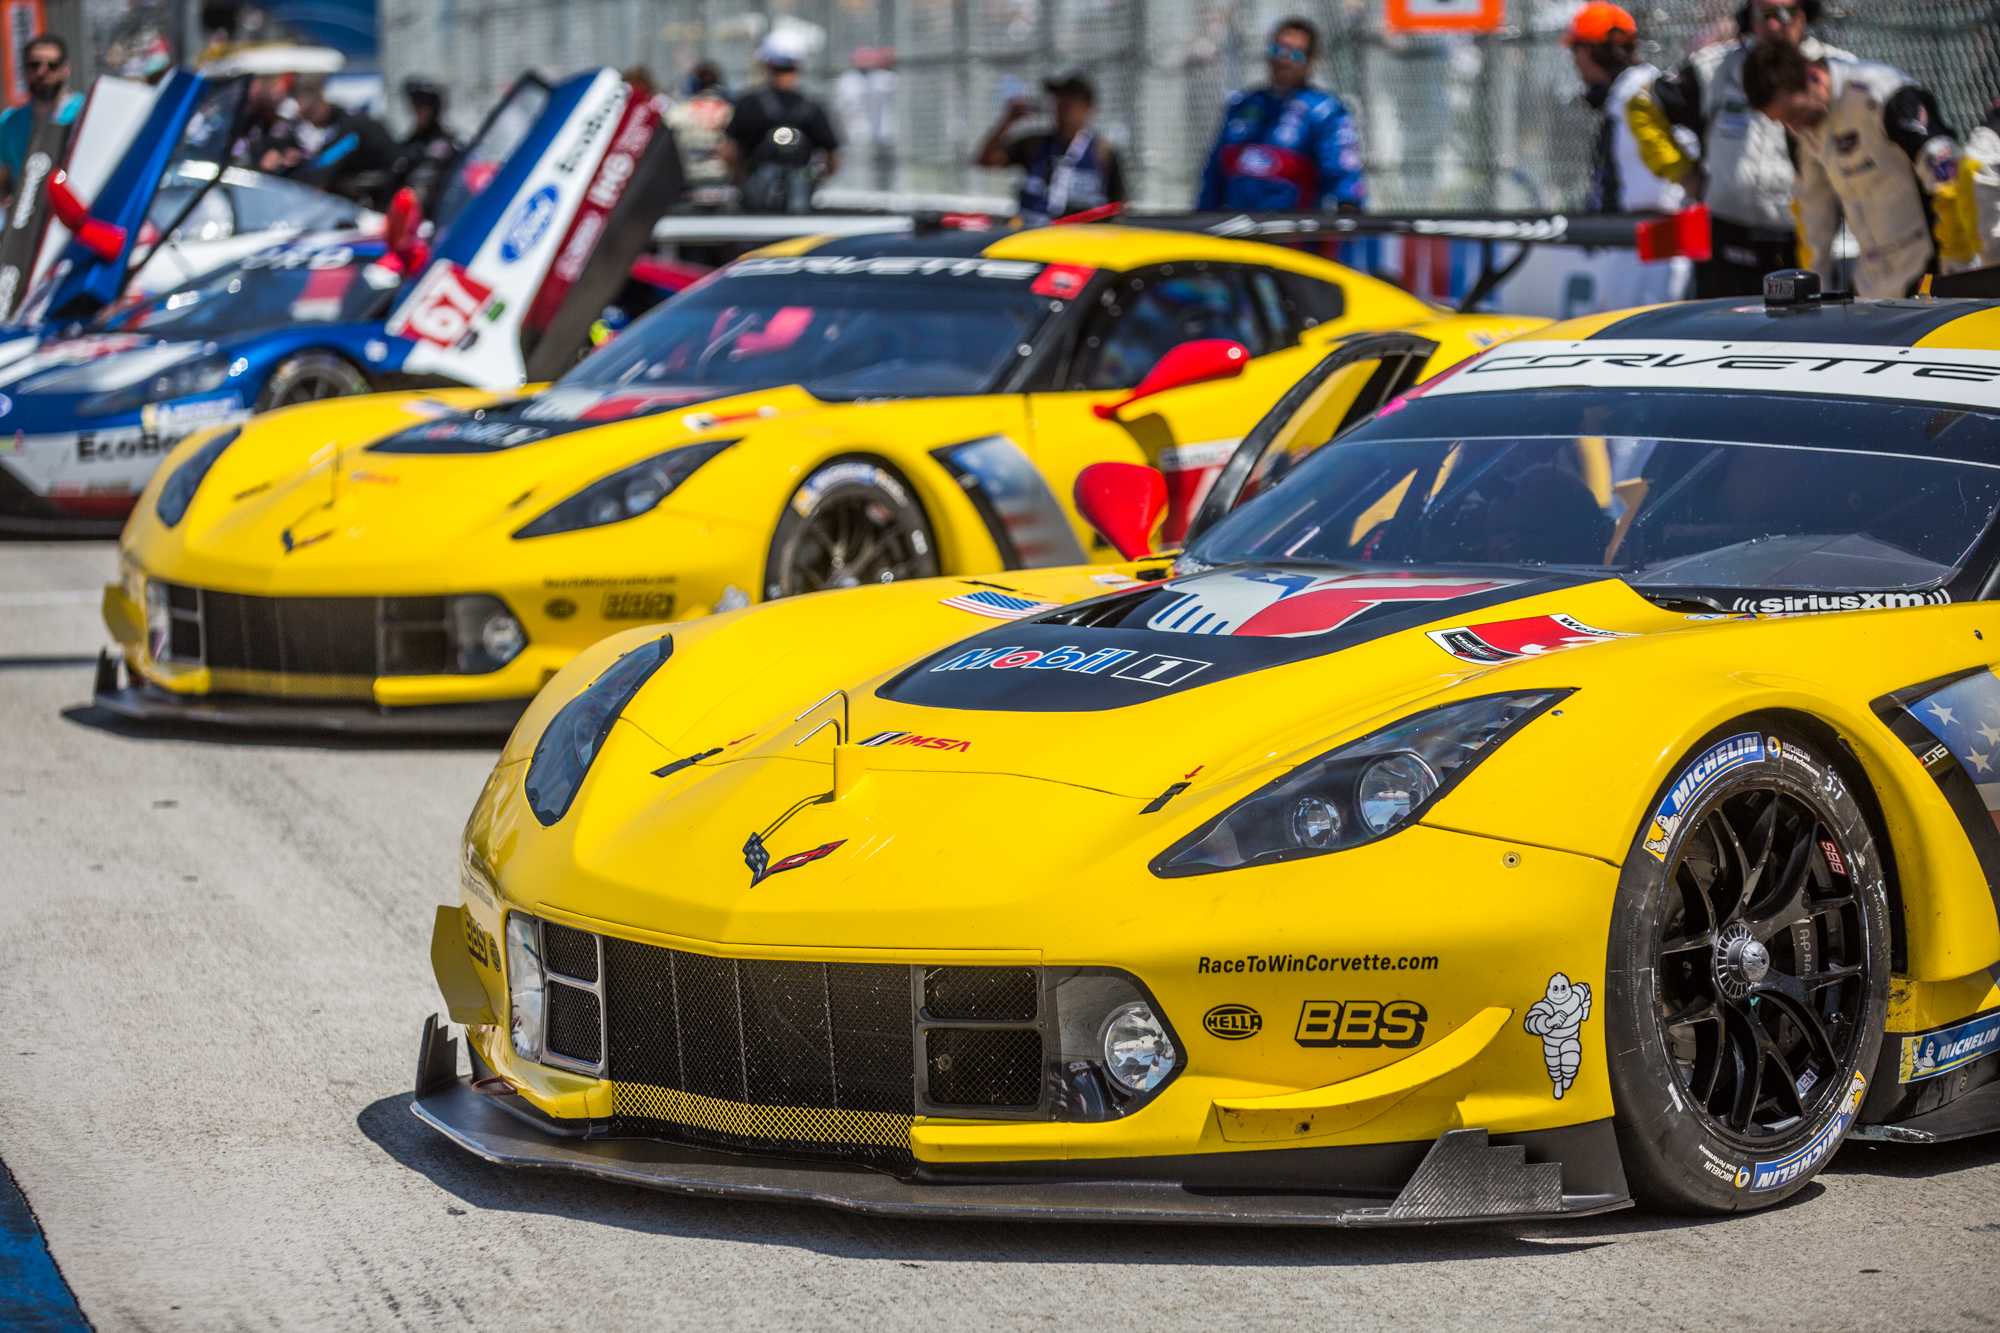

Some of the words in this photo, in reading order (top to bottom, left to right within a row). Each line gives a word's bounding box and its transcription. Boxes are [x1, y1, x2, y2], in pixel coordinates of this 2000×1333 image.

[723, 255, 1043, 281] CORVETTE
[408, 270, 488, 346] 67
[1465, 352, 2000, 383] CORVETTE
[77, 427, 186, 463] EcoBo
[930, 646, 1138, 674] Mobil
[890, 734, 972, 753] IMSA
[1782, 741, 1811, 763] MICHELIN
[1671, 736, 1758, 810] MICHELIN
[1793, 755, 1821, 778] Performance
[1822, 841, 1845, 875] BBS
[1800, 929, 1811, 951] AP
[1198, 954, 1439, 974] RaceToWinCorvette.com
[1803, 953, 1812, 977] RA
[1206, 1012, 1262, 1033] HELLA
[1294, 1000, 1428, 1049] BBS
[1937, 1027, 2000, 1062] MICHELIN
[1698, 1144, 1725, 1169] Performance
[1755, 1118, 1842, 1188] MICHELIN
[1703, 1160, 1735, 1183] MICHELIN
